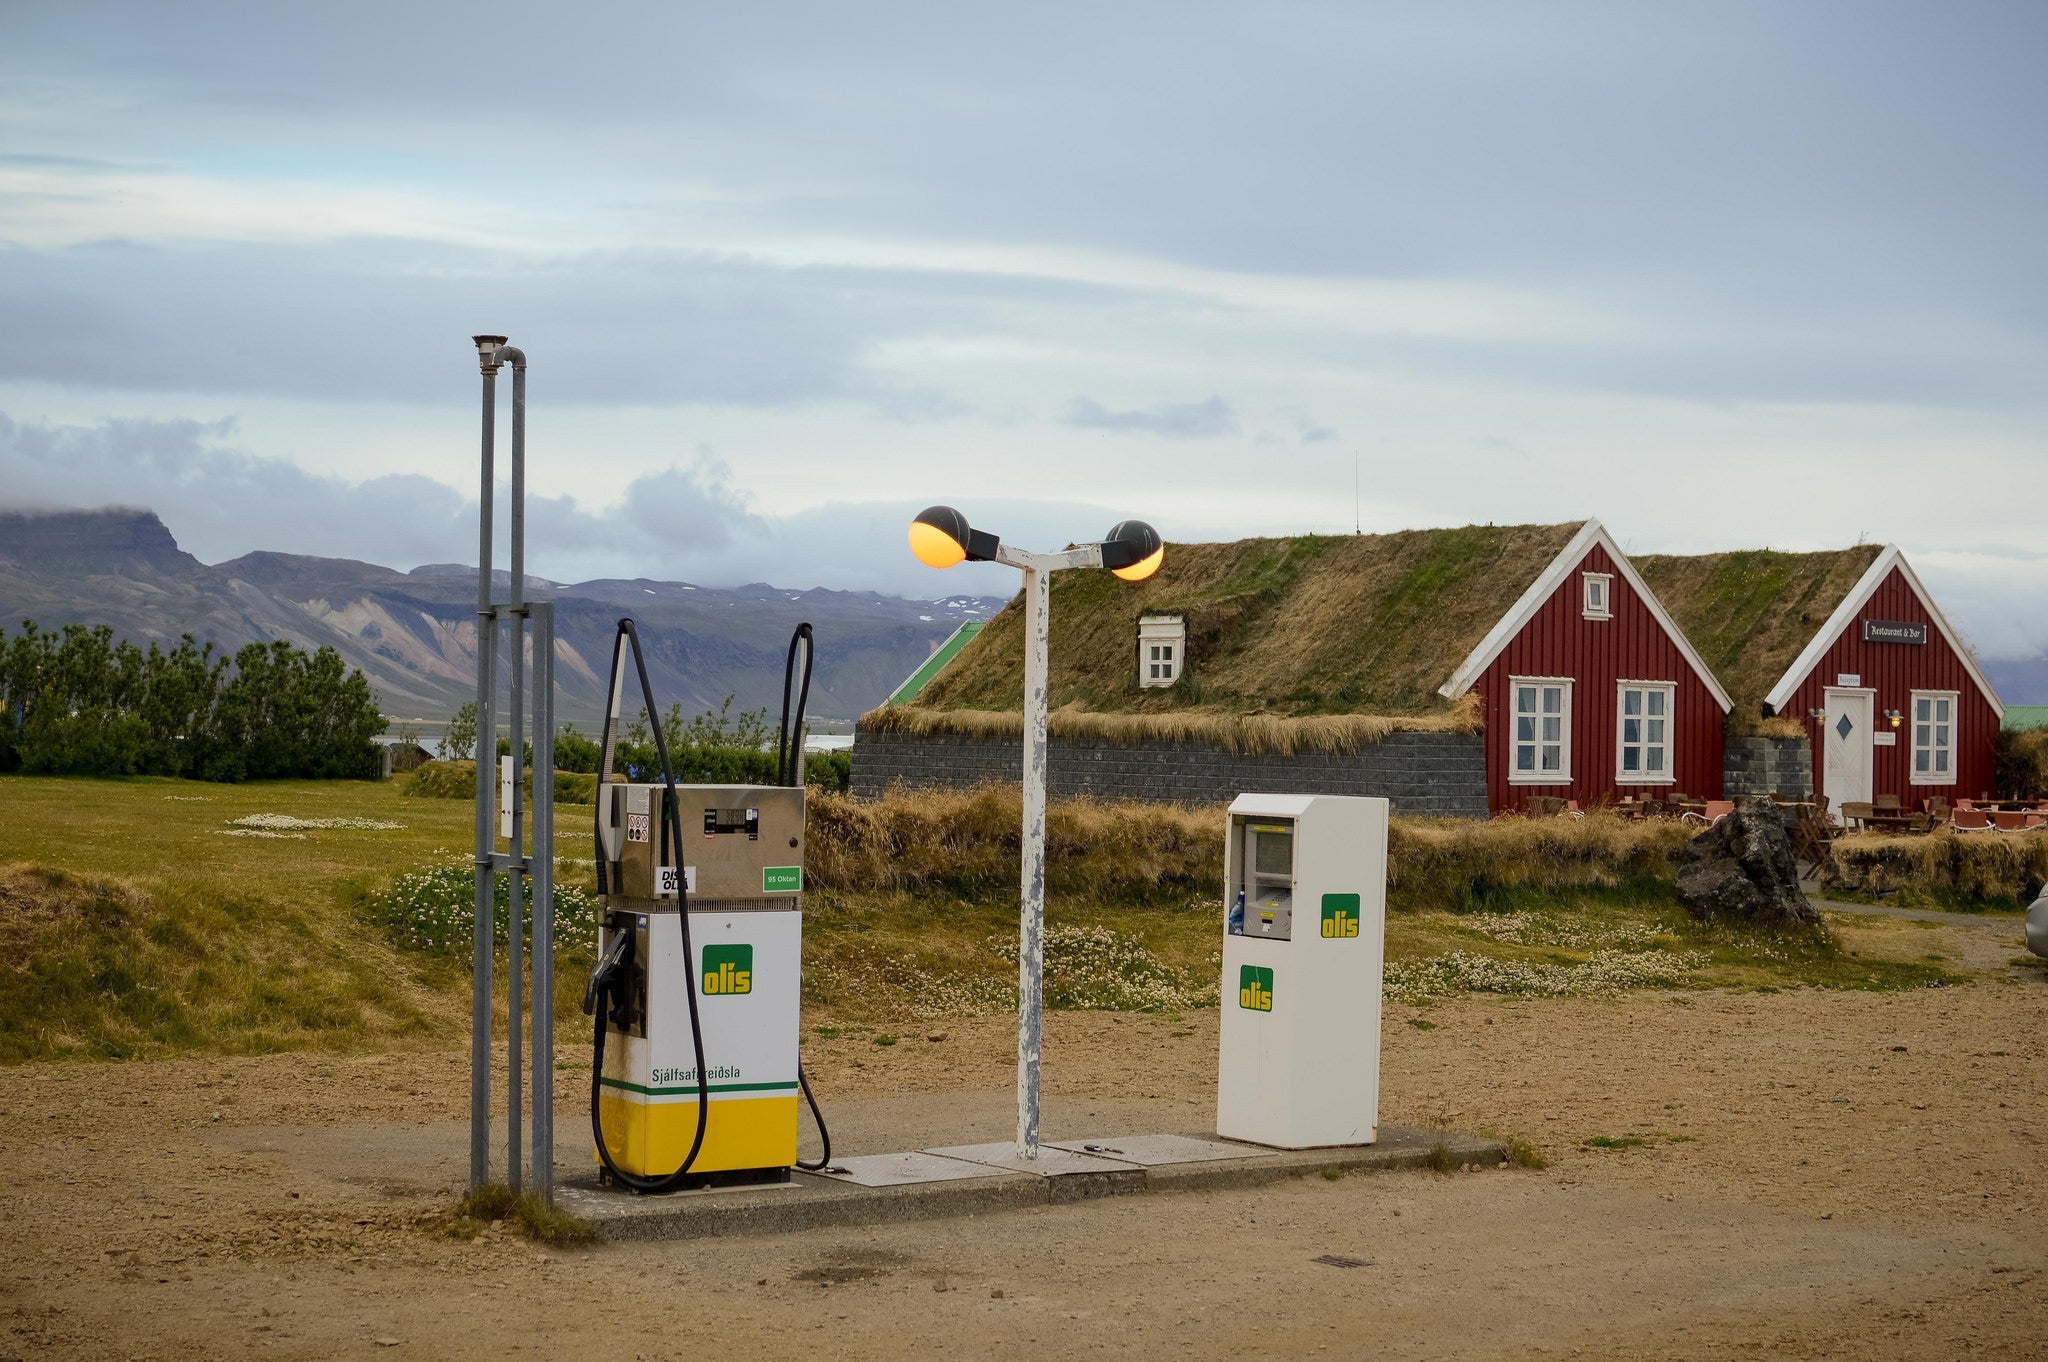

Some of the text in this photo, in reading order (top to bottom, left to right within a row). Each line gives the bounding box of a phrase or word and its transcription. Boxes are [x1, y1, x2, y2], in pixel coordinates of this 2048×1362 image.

[1871, 625, 1921, 638] Restaurant & Bar
[767, 875, 797, 883] 95 Oktan
[704, 962, 750, 994] olís
[652, 1065, 740, 1085] Sjálfsafeiðsla
